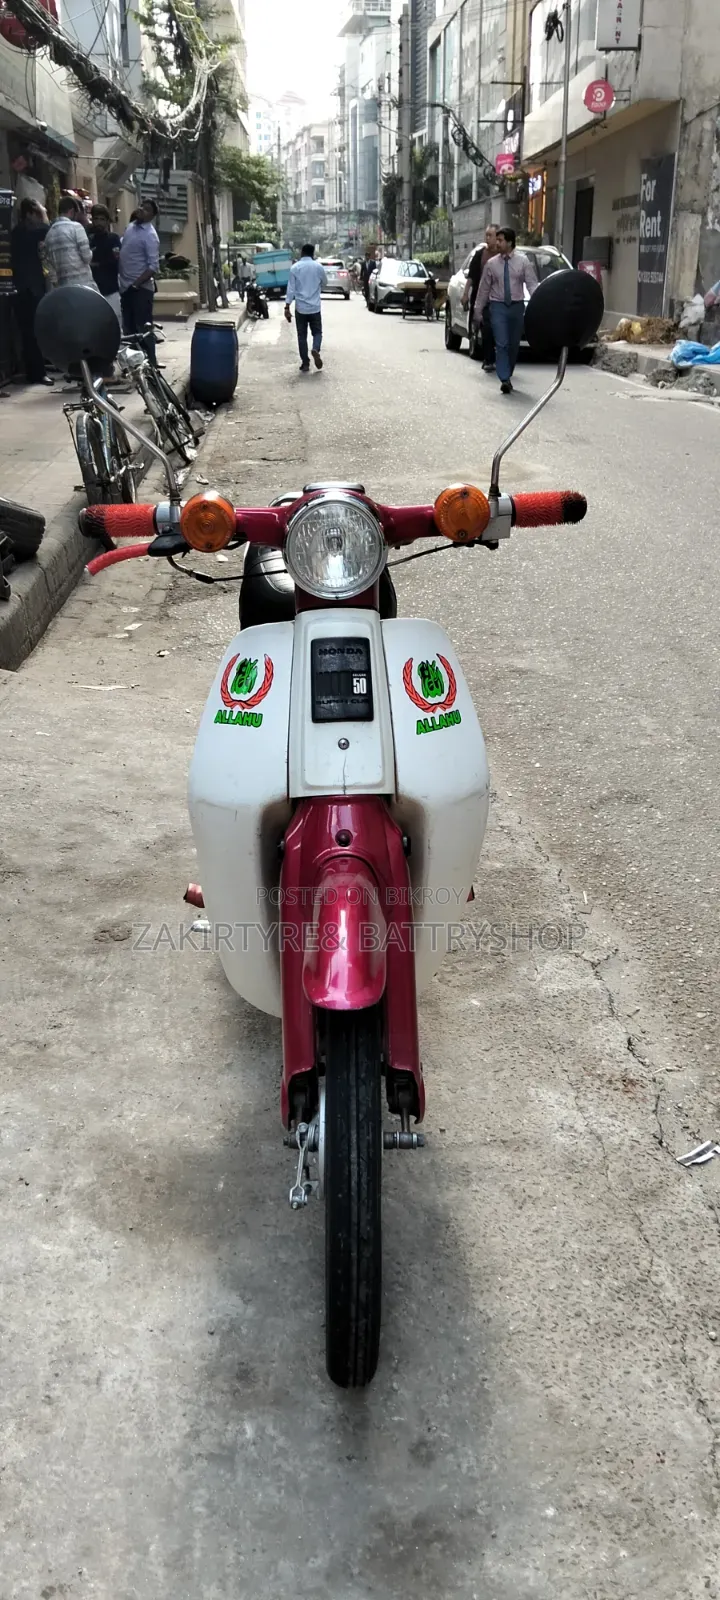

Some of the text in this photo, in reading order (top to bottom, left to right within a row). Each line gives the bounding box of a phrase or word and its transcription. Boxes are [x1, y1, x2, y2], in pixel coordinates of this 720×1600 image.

[641, 173, 656, 202] For
[640, 210, 661, 238] Rent
[318, 647, 364, 656] HONDA
[353, 677, 367, 694] 50
[213, 709, 263, 728] ALLAHU
[416, 709, 462, 735] ALLAHU
